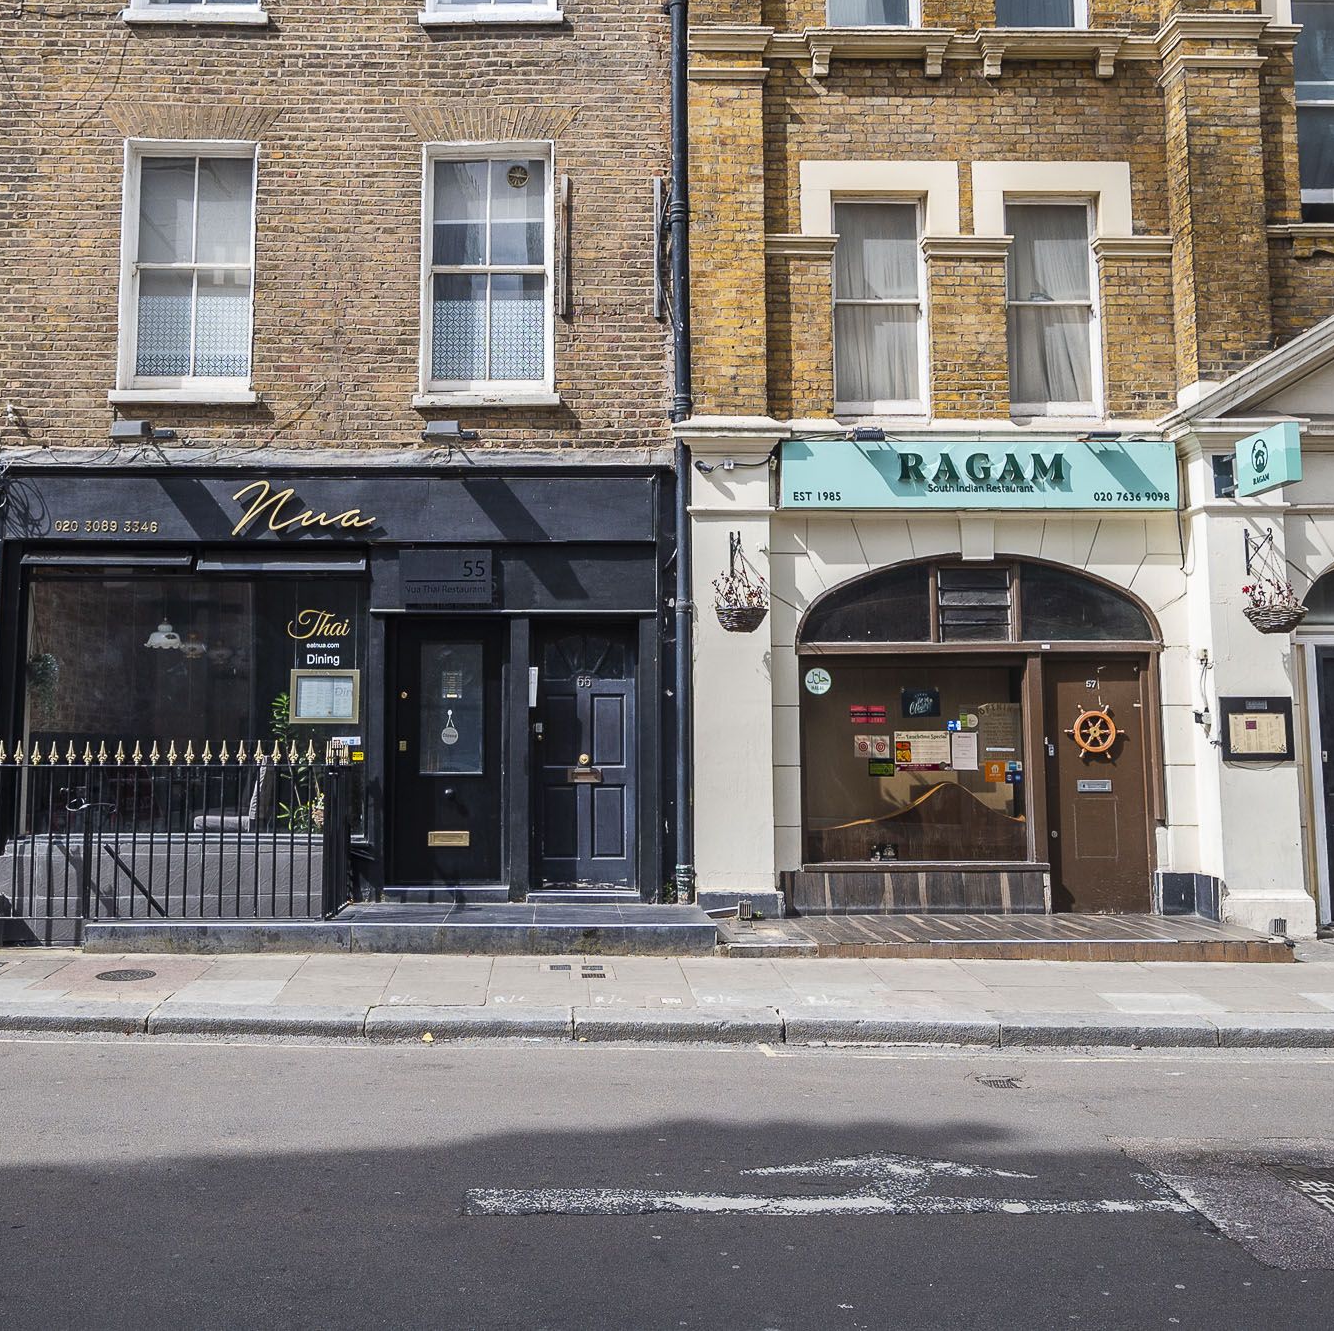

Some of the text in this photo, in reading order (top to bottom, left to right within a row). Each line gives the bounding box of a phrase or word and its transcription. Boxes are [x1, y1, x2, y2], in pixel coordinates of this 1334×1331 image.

[897, 453, 1065, 482] RAGAM
[1252, 472, 1270, 485] RAGAM
[928, 484, 1034, 493] South Indian Restaurant
[793, 491, 841, 502] EST 1985
[1093, 492, 1170, 502] 020 7636 9098
[232, 480, 377, 537] Nua
[54, 520, 158, 534] 020 3089 3346
[462, 560, 485, 577] 55
[423, 585, 440, 593] Thai
[443, 585, 486, 593] Restaurant
[287, 609, 352, 639] Thai
[306, 654, 340, 666] Dining
[1085, 680, 1097, 688] 57
